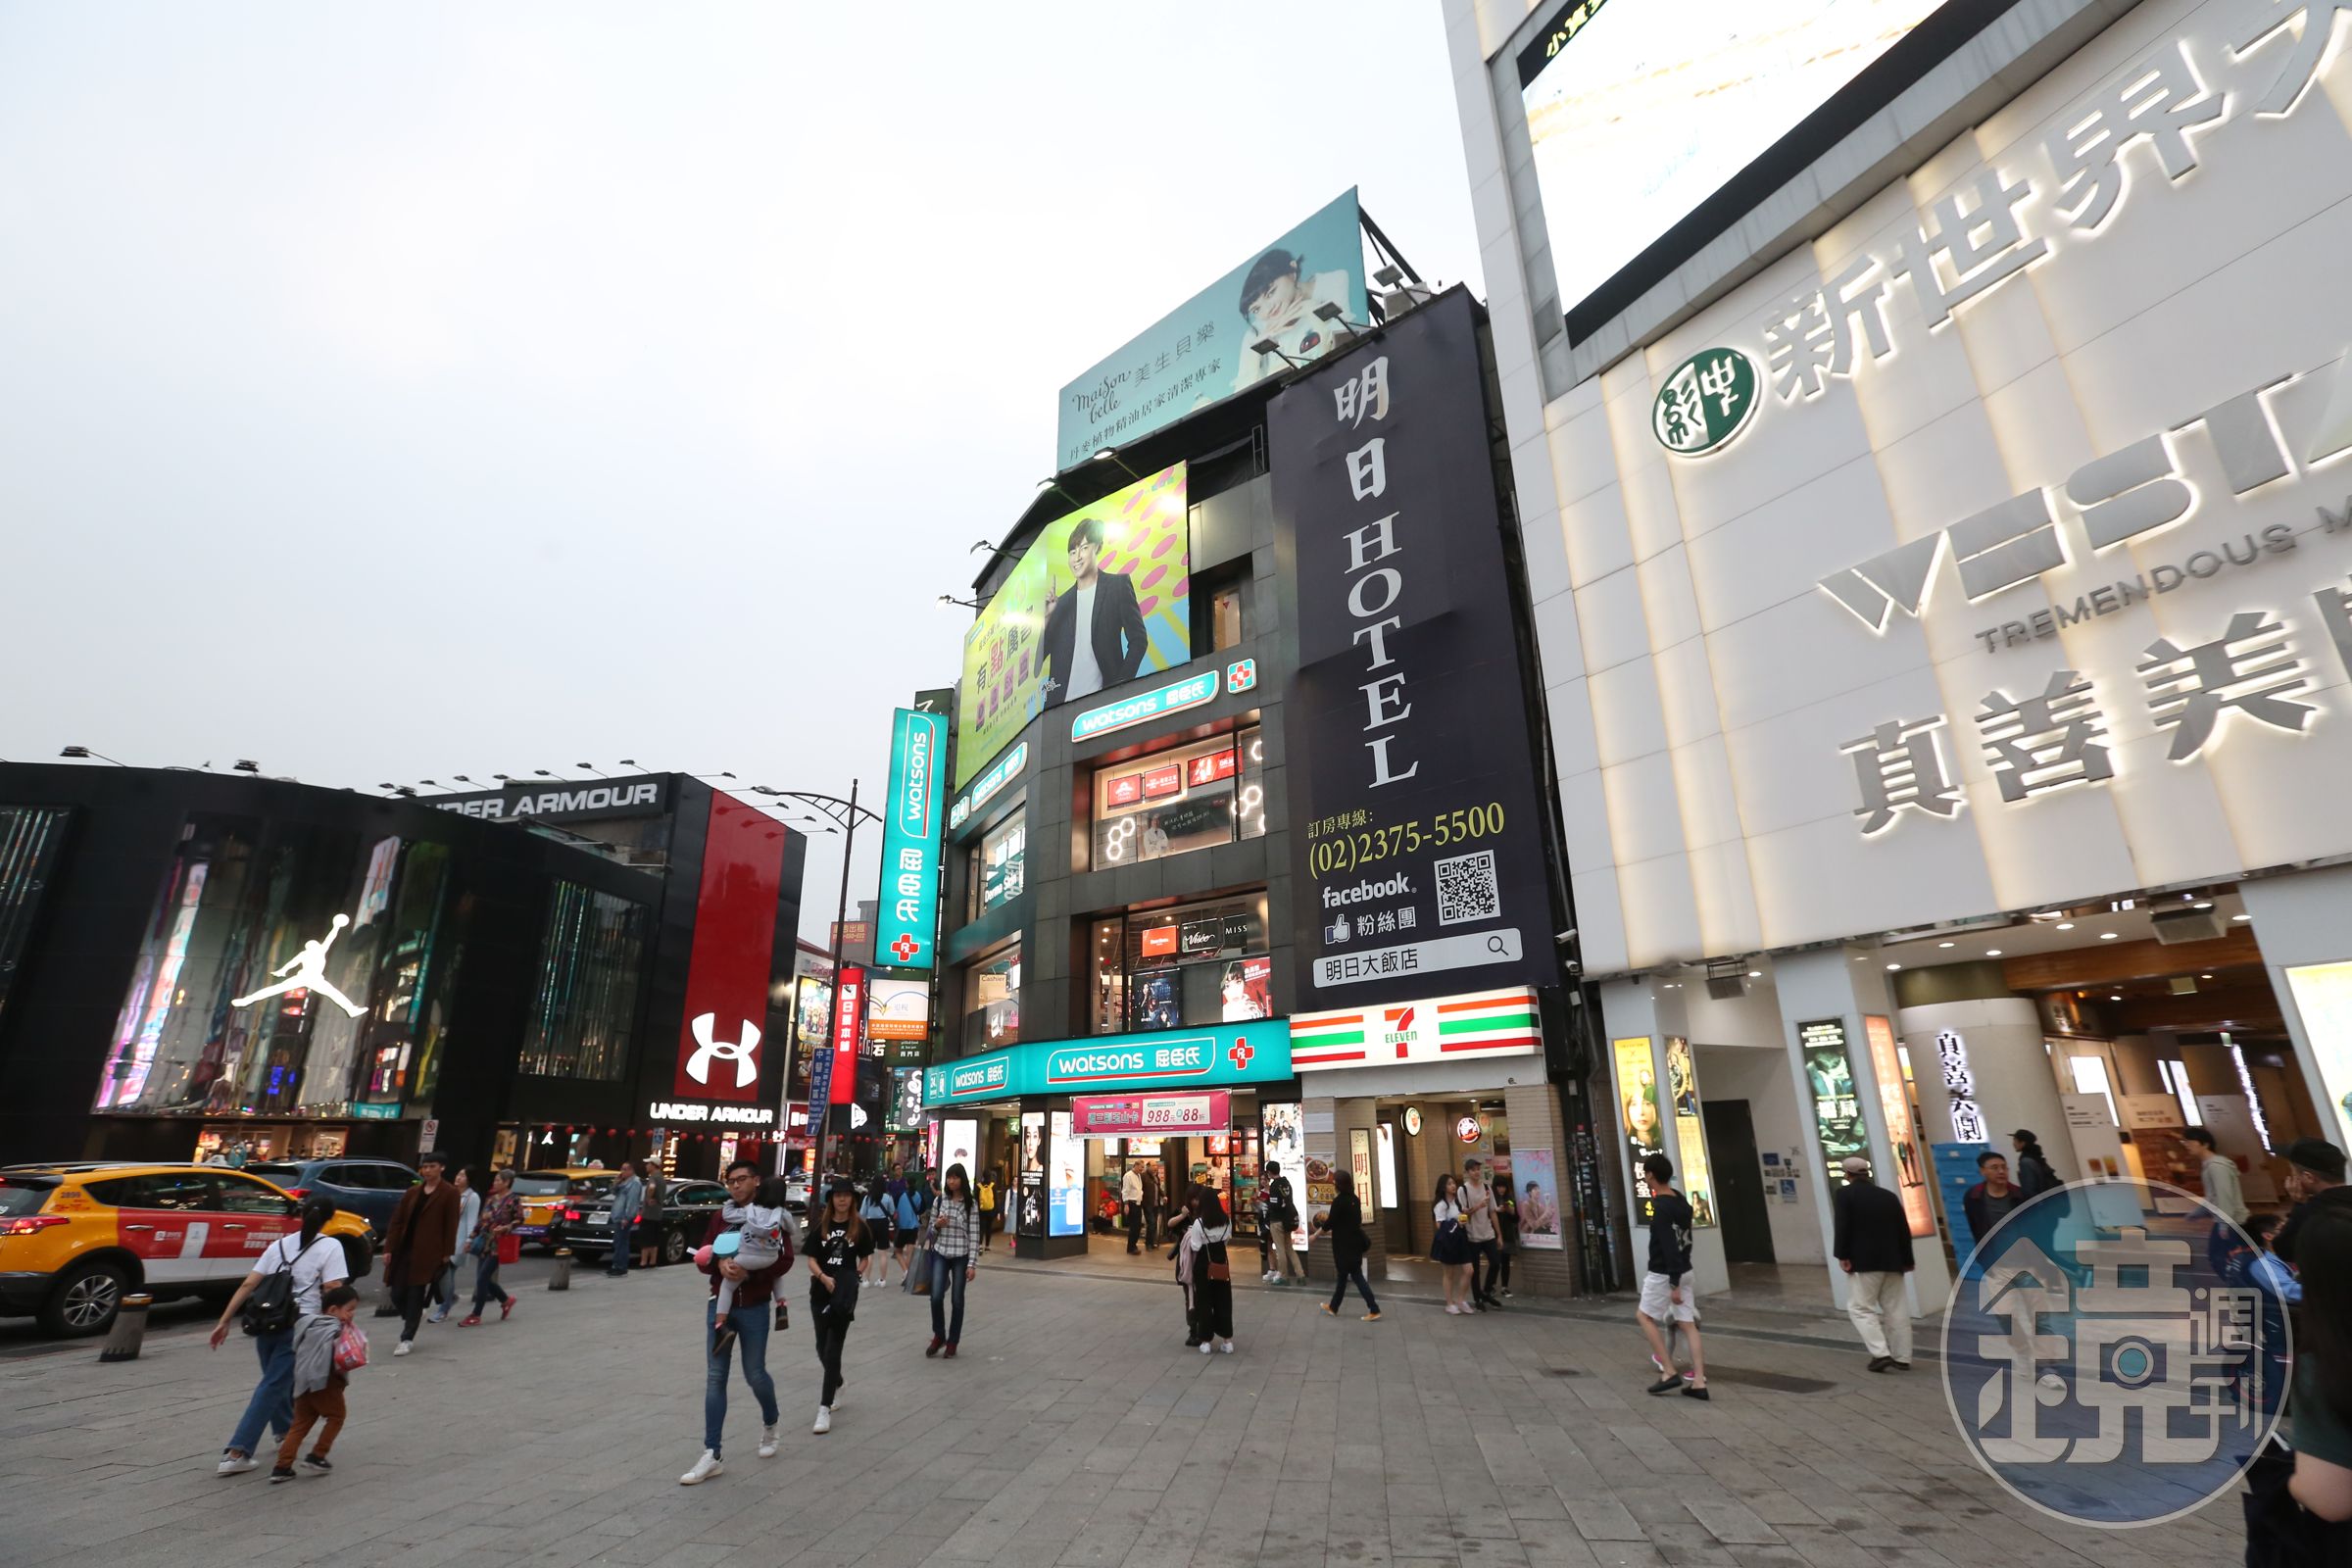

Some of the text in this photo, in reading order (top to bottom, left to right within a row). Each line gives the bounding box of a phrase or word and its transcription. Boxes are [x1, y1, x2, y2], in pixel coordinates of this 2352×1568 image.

[1090, 391, 1121, 424] belle
[1334, 356, 1419, 789] 明日 HOTEL
[1976, 524, 2298, 654] TREMENDOUS
[1082, 680, 1205, 731] watsons 屈臣氏
[1840, 571, 2352, 836] 真善美
[907, 731, 927, 821] watsons
[512, 783, 658, 816] ARMOUR
[1309, 802, 1506, 880] (02)2375-5500
[896, 848, 923, 923] 屈臣氏
[1323, 872, 1410, 908] facebook
[1225, 924, 1248, 935] MISS
[1356, 906, 1417, 937] 粉絲團
[1325, 949, 1419, 981] 明日大飯店
[1058, 1047, 1200, 1074] watsons 屈臣氏
[955, 1070, 985, 1089] watsons
[650, 1102, 709, 1121] UNDER
[710, 1106, 773, 1124] ARMOUR
[1354, 1152, 1369, 1207] 明日
